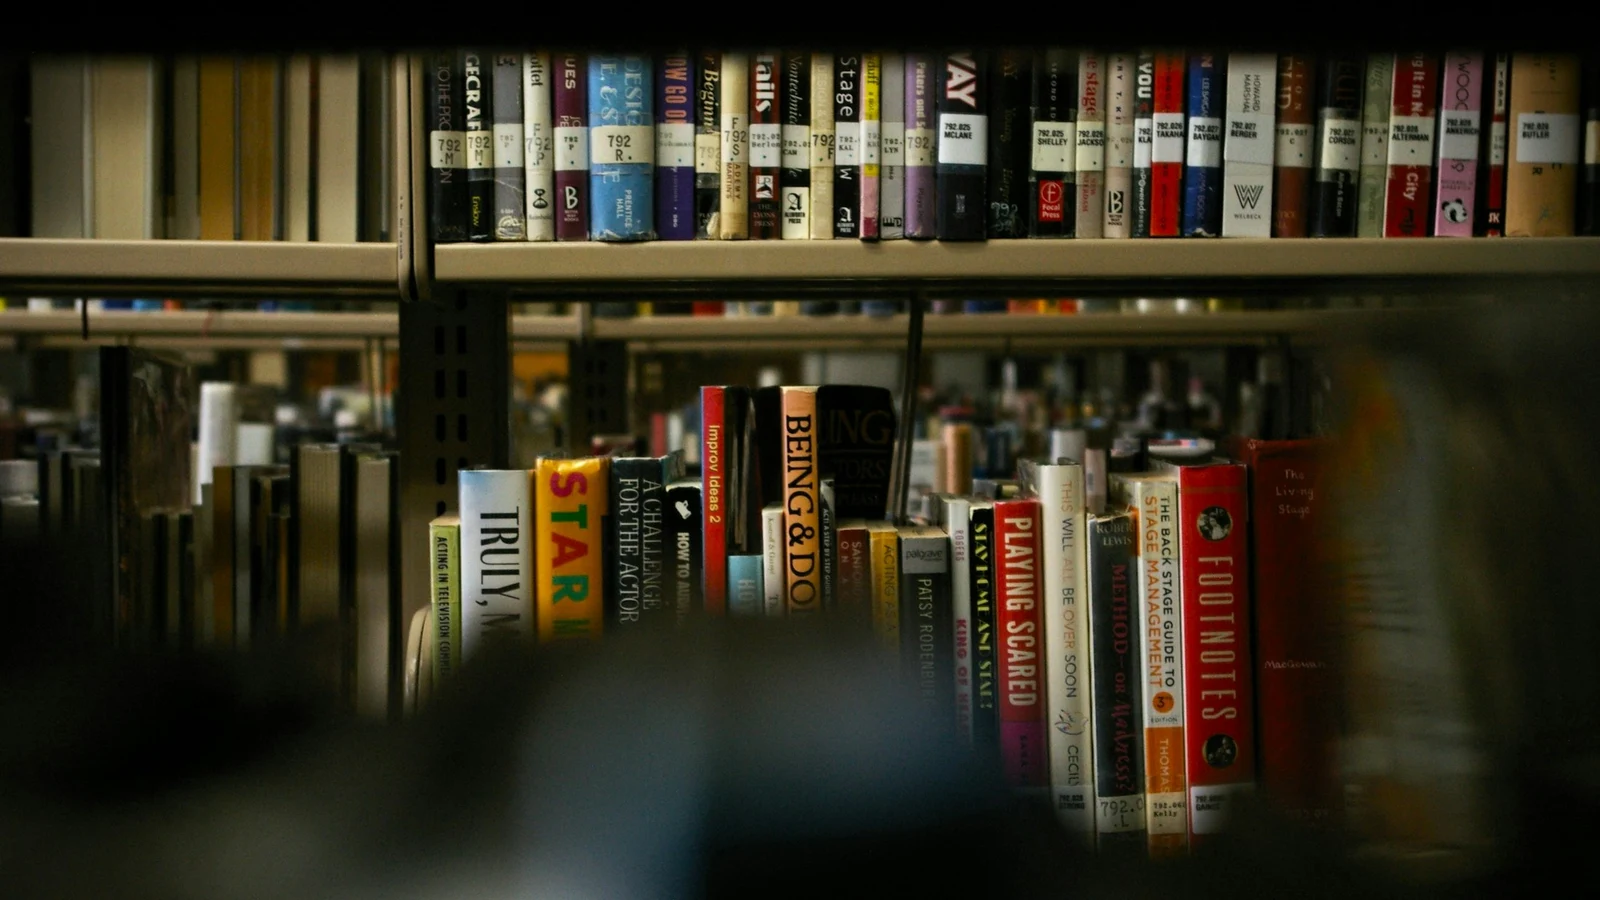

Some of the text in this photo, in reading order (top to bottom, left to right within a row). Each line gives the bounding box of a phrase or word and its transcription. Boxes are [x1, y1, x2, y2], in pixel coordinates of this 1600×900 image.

[665, 85, 687, 104] GO
[836, 56, 857, 117] Stage
[1081, 72, 1099, 116] stage
[1138, 63, 1152, 98] YOU
[1252, 74, 1261, 112] HOWARD
[1412, 84, 1426, 98] in
[438, 139, 461, 152] 792
[467, 137, 490, 149] 792
[607, 136, 632, 148] 792
[724, 131, 747, 143] 792
[812, 134, 835, 147] 792
[908, 136, 930, 149] 792
[944, 131, 973, 139] MCLANE
[1037, 137, 1068, 146] SHELLEY
[1230, 129, 1257, 139] BERGER
[1392, 133, 1429, 141] ALTERMAN
[1522, 131, 1550, 139] BUTLER
[1403, 172, 1419, 201] City
[625, 190, 633, 229] PRENTICE
[1042, 203, 1060, 211] Focal
[1042, 211, 1060, 219] Press
[707, 424, 721, 523] Improv Ideas 2
[785, 414, 815, 547] BEING &
[1278, 503, 1311, 517] Stage
[549, 471, 589, 605] STAR
[619, 477, 640, 624] FOR THE ACTOR
[643, 479, 663, 611] A CHALLENGE
[677, 532, 690, 578] HOW TO
[906, 549, 943, 561] palgrave
[954, 529, 965, 562] ROGERS
[475, 505, 520, 608] TRULY,
[883, 544, 896, 596] ACTING
[437, 537, 450, 640] ACTING IN TELEVISION
[917, 578, 932, 619] PATSY
[1061, 480, 1077, 698] THIS WILL ALL BE OVER SOON
[1145, 496, 1163, 688] STAGE MANAGEMENT
[1160, 495, 1175, 687] THE BACK STAGE GUIDE TO
[1004, 517, 1037, 707] PLAYING SCARED
[956, 619, 968, 686] KING OF
[1198, 556, 1237, 720] FOOTNOTES
[1153, 810, 1177, 818] Kelly
